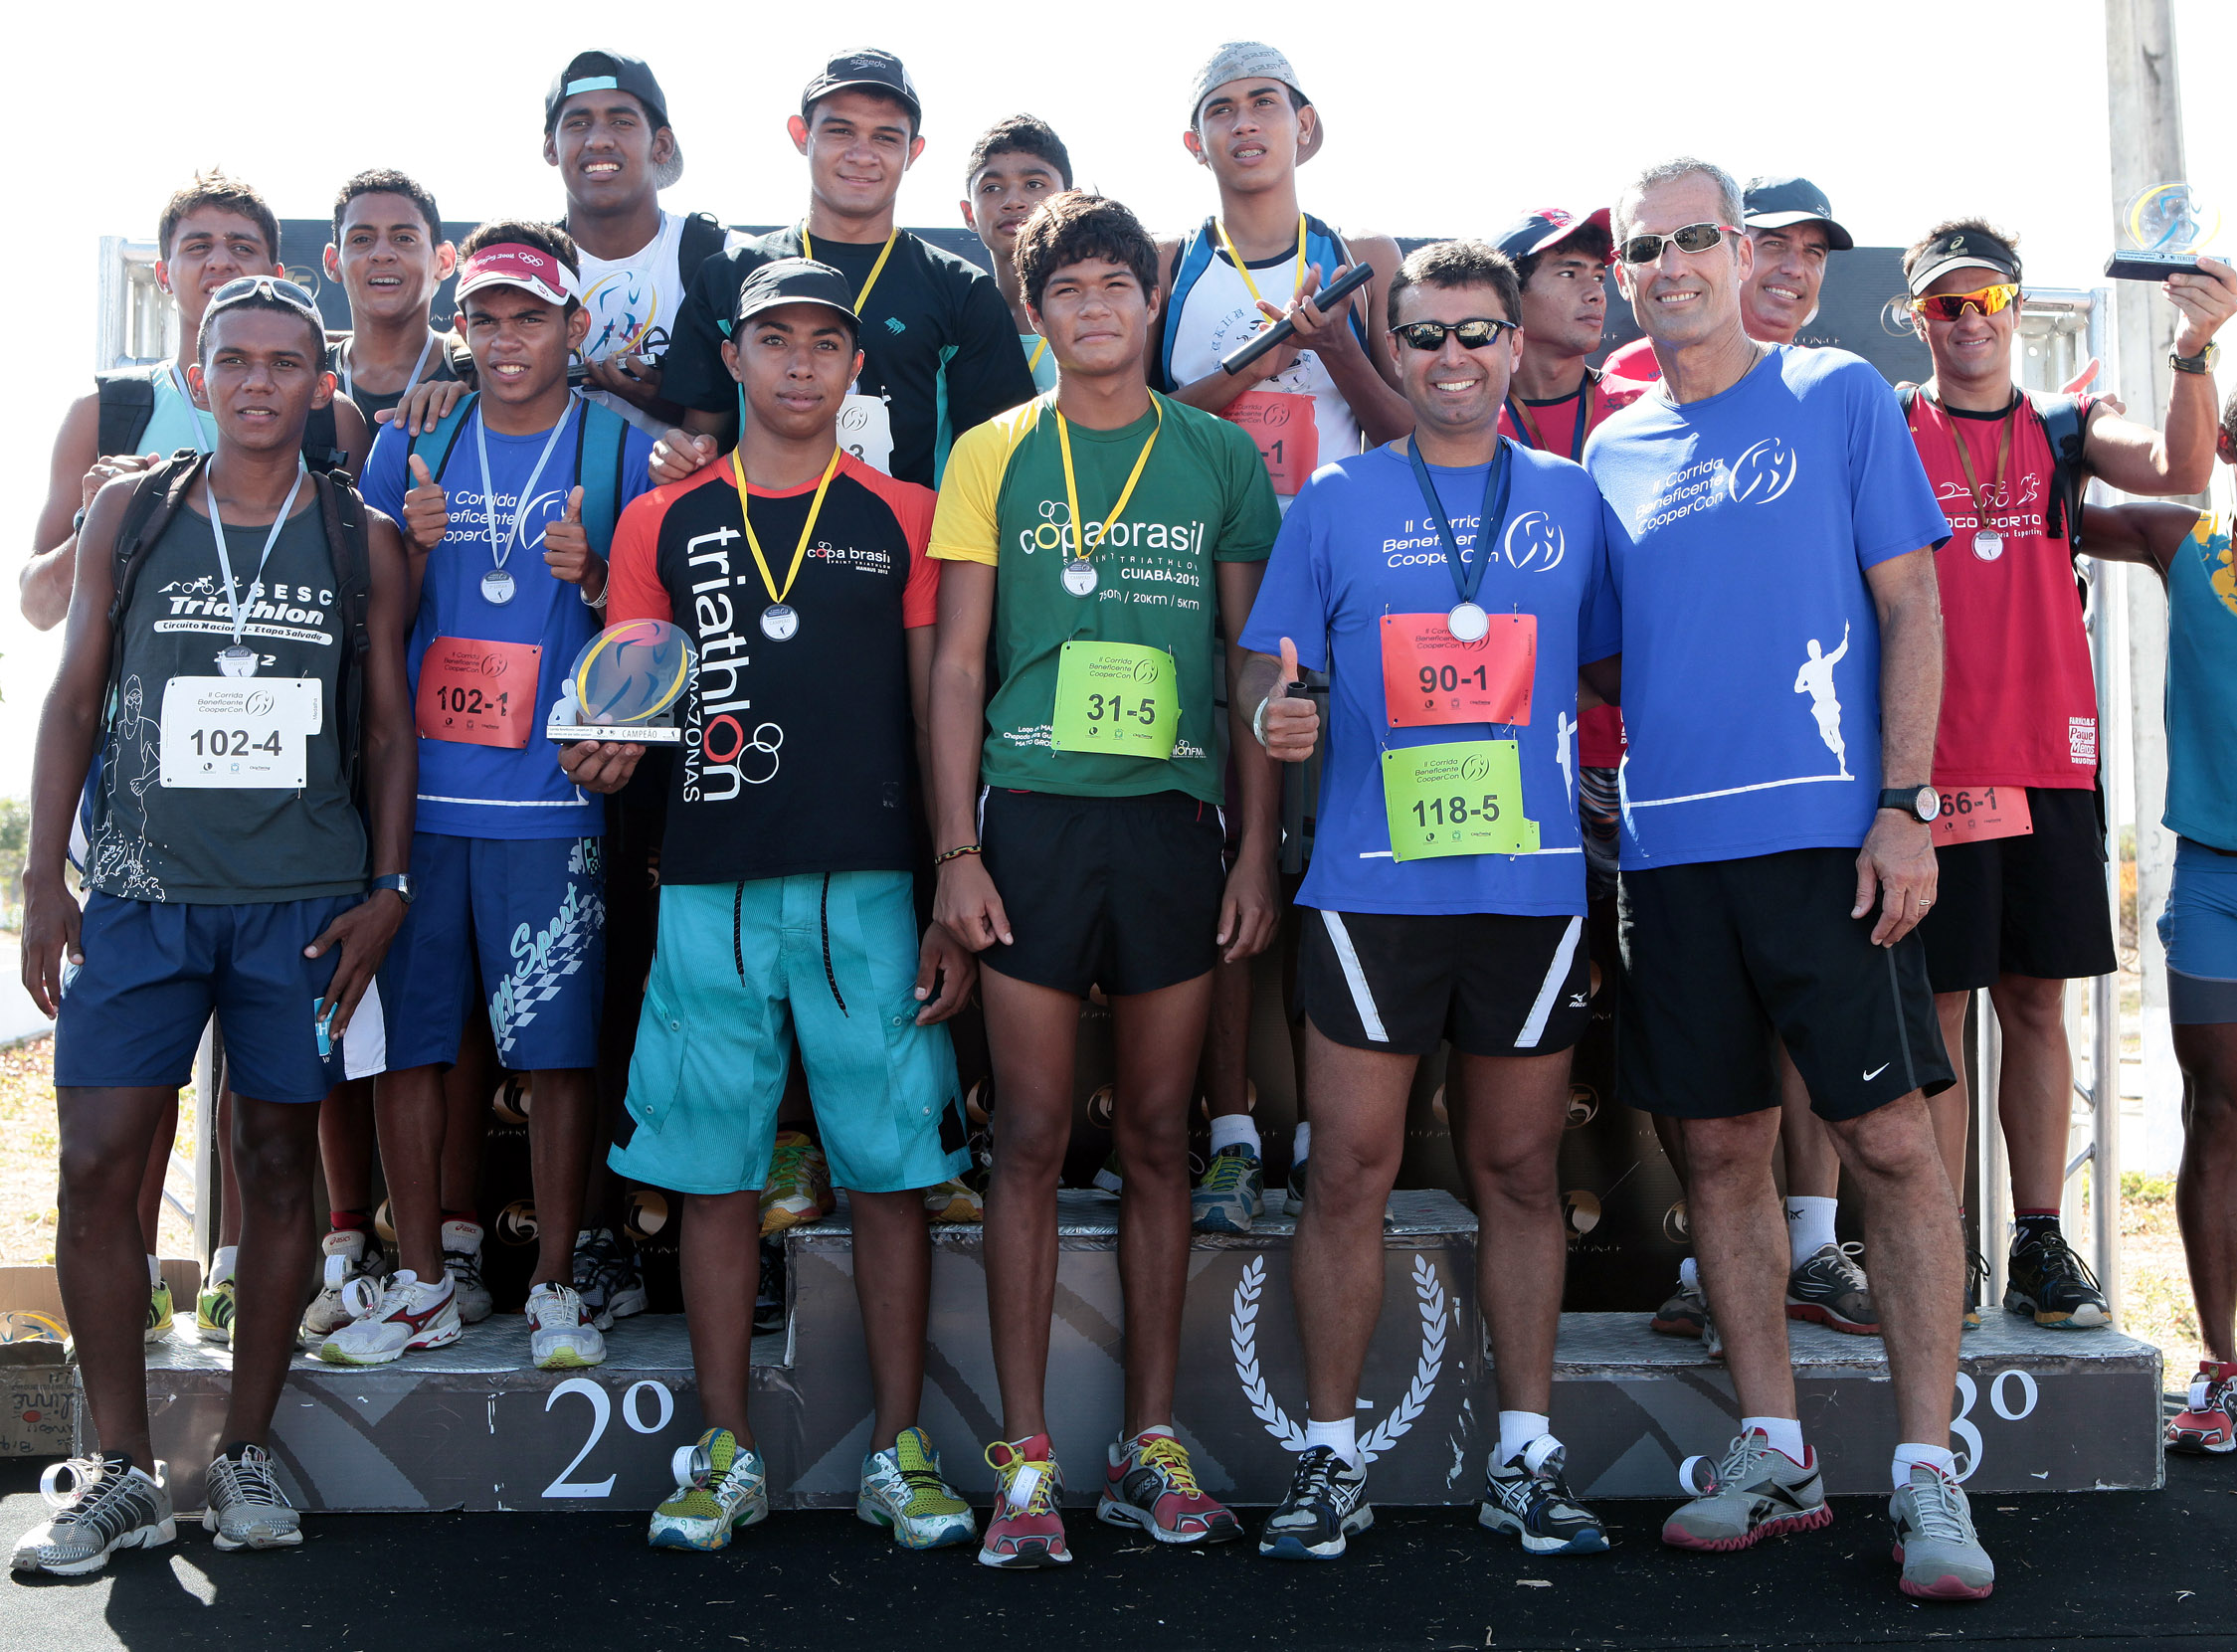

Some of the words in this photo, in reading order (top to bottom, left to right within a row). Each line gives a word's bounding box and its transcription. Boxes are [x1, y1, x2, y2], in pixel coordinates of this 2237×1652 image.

[849, 59, 886, 69] speedo
[1653, 480, 1661, 494] II
[1665, 459, 1724, 487] Corrida
[1635, 474, 1724, 520] Beneficente
[1636, 491, 1724, 535] CooperCon
[1404, 520, 1413, 533] II
[807, 548, 845, 564] copa
[849, 547, 890, 564] brasil
[1121, 568, 1200, 588] CUIABÁ-2012
[250, 582, 333, 606] SESC
[169, 596, 324, 626] Triathlon
[163, 621, 199, 630] Circuito
[255, 626, 284, 636] Etapa
[444, 657, 479, 666] Beneficente
[444, 664, 479, 673] CooperCon
[686, 526, 751, 802] triathlon
[1089, 663, 1132, 672] Beneficente
[1105, 656, 1133, 665] Corrida
[1089, 670, 1131, 679] CooperCon
[1418, 664, 1487, 694] 90-1
[437, 685, 508, 717] 102-1
[1086, 693, 1156, 725] 31-5
[622, 728, 657, 739] CAMPEÃO
[682, 648, 703, 804] AMAZONAS
[190, 729, 282, 757] 102-4
[1414, 766, 1459, 776] Beneficente
[1430, 758, 1458, 767] Corrida
[1416, 774, 1459, 784] CooperCon
[1412, 794, 1500, 827] 118-5
[510, 881, 580, 979] Sport
[541, 1377, 674, 1498] 2º
[1950, 1369, 2038, 1485] 3º
